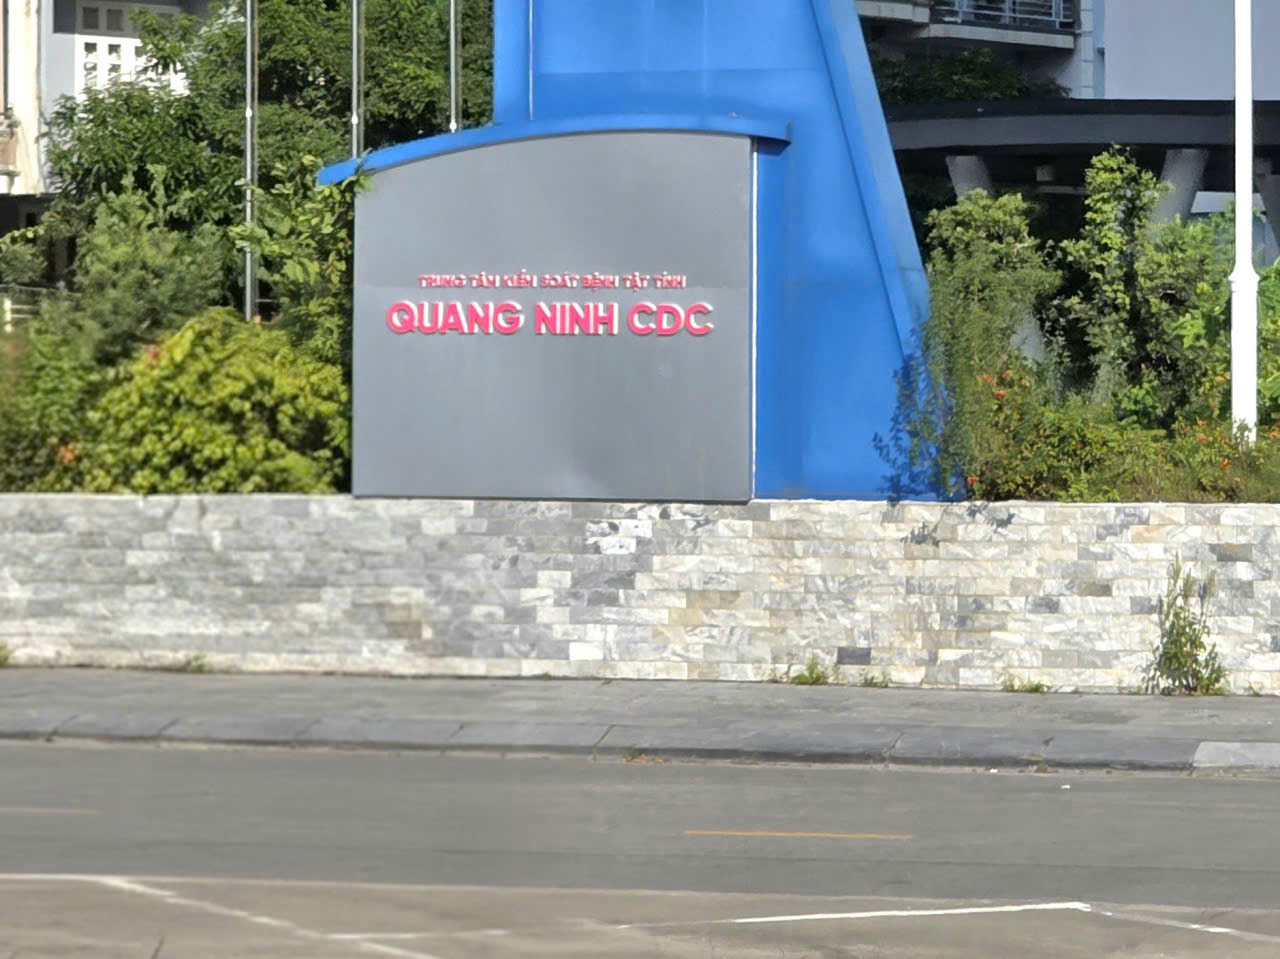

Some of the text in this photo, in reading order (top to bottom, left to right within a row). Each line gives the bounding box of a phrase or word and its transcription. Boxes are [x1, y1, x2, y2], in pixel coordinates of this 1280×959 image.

[418, 274, 467, 288] TRUNG
[469, 271, 500, 288] TÂM
[386, 300, 714, 335] QUANG NINH CDC
